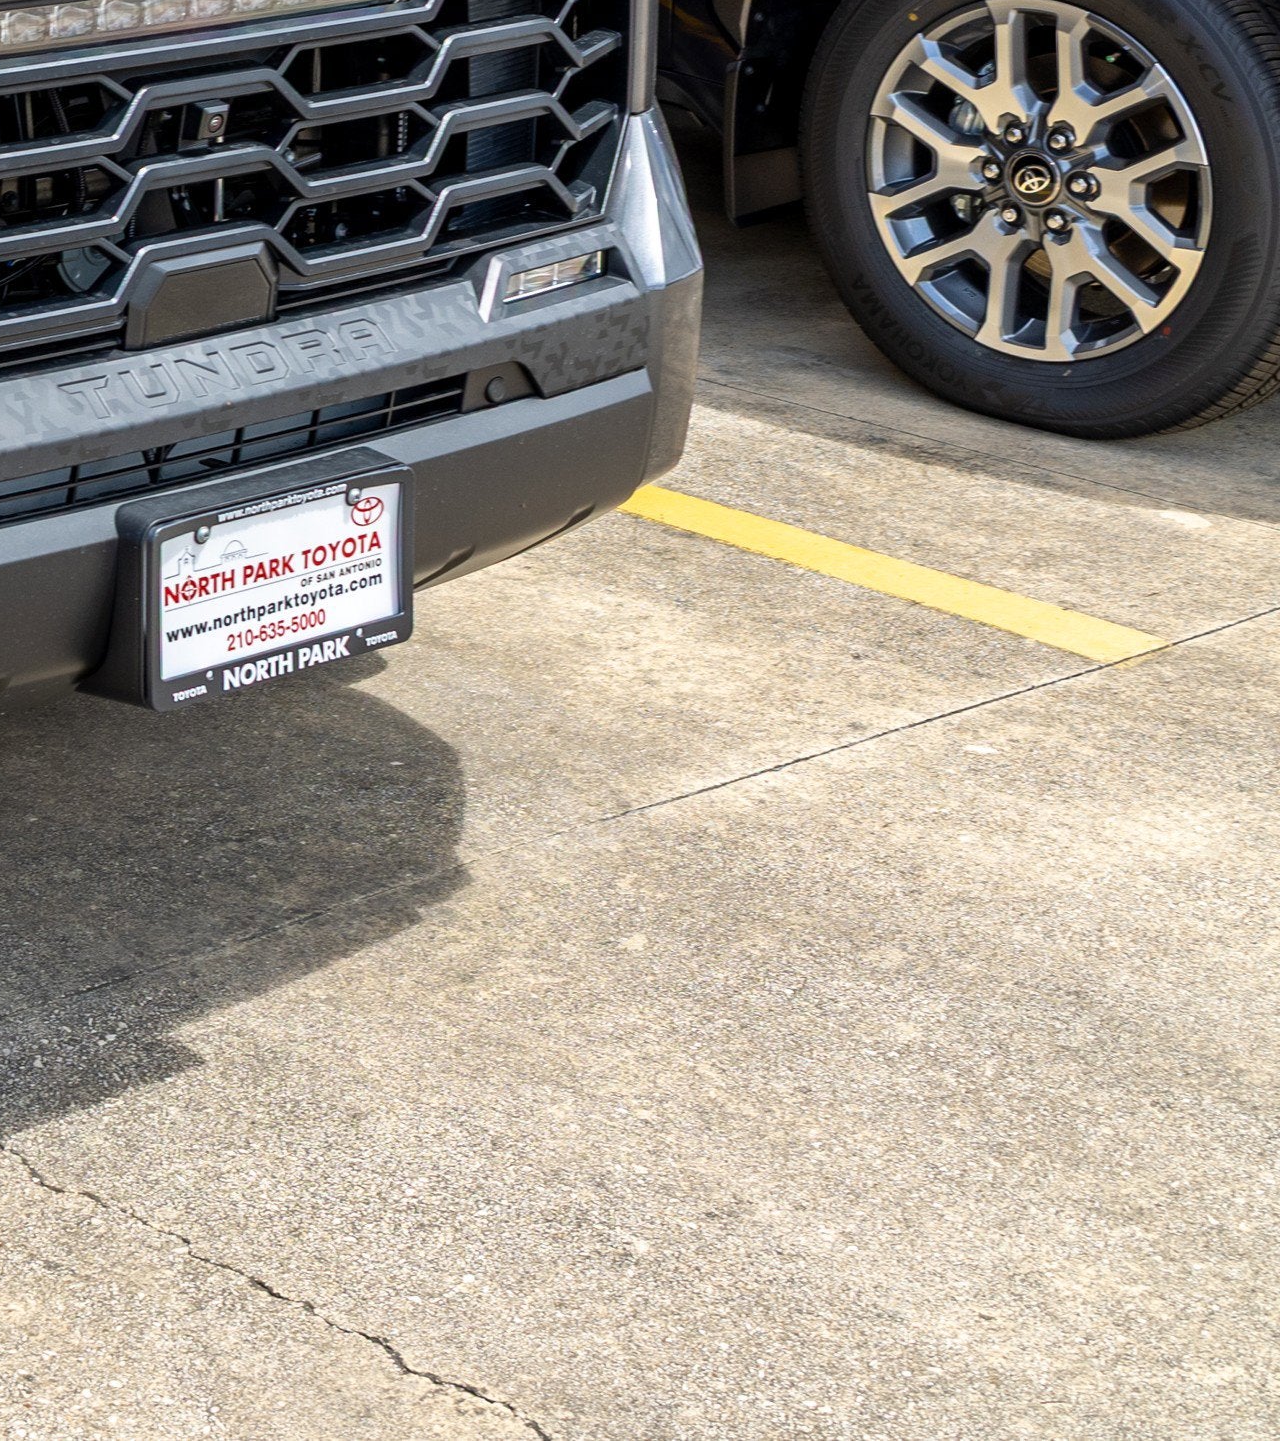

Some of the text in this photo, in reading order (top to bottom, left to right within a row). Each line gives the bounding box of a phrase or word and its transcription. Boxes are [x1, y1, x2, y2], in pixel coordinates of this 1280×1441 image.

[58, 319, 395, 419] TUNDRA
[164, 531, 382, 607] NORTH PARK TOYOTA
[300, 558, 382, 588] OF SAN ANTONIO
[166, 572, 383, 643] www.northparktoyota.com
[226, 608, 327, 652] 210-635-5000
[222, 635, 350, 691] NORTH PARK
[365, 629, 398, 647] TOYOTA
[172, 684, 207, 703] TOYOTA
